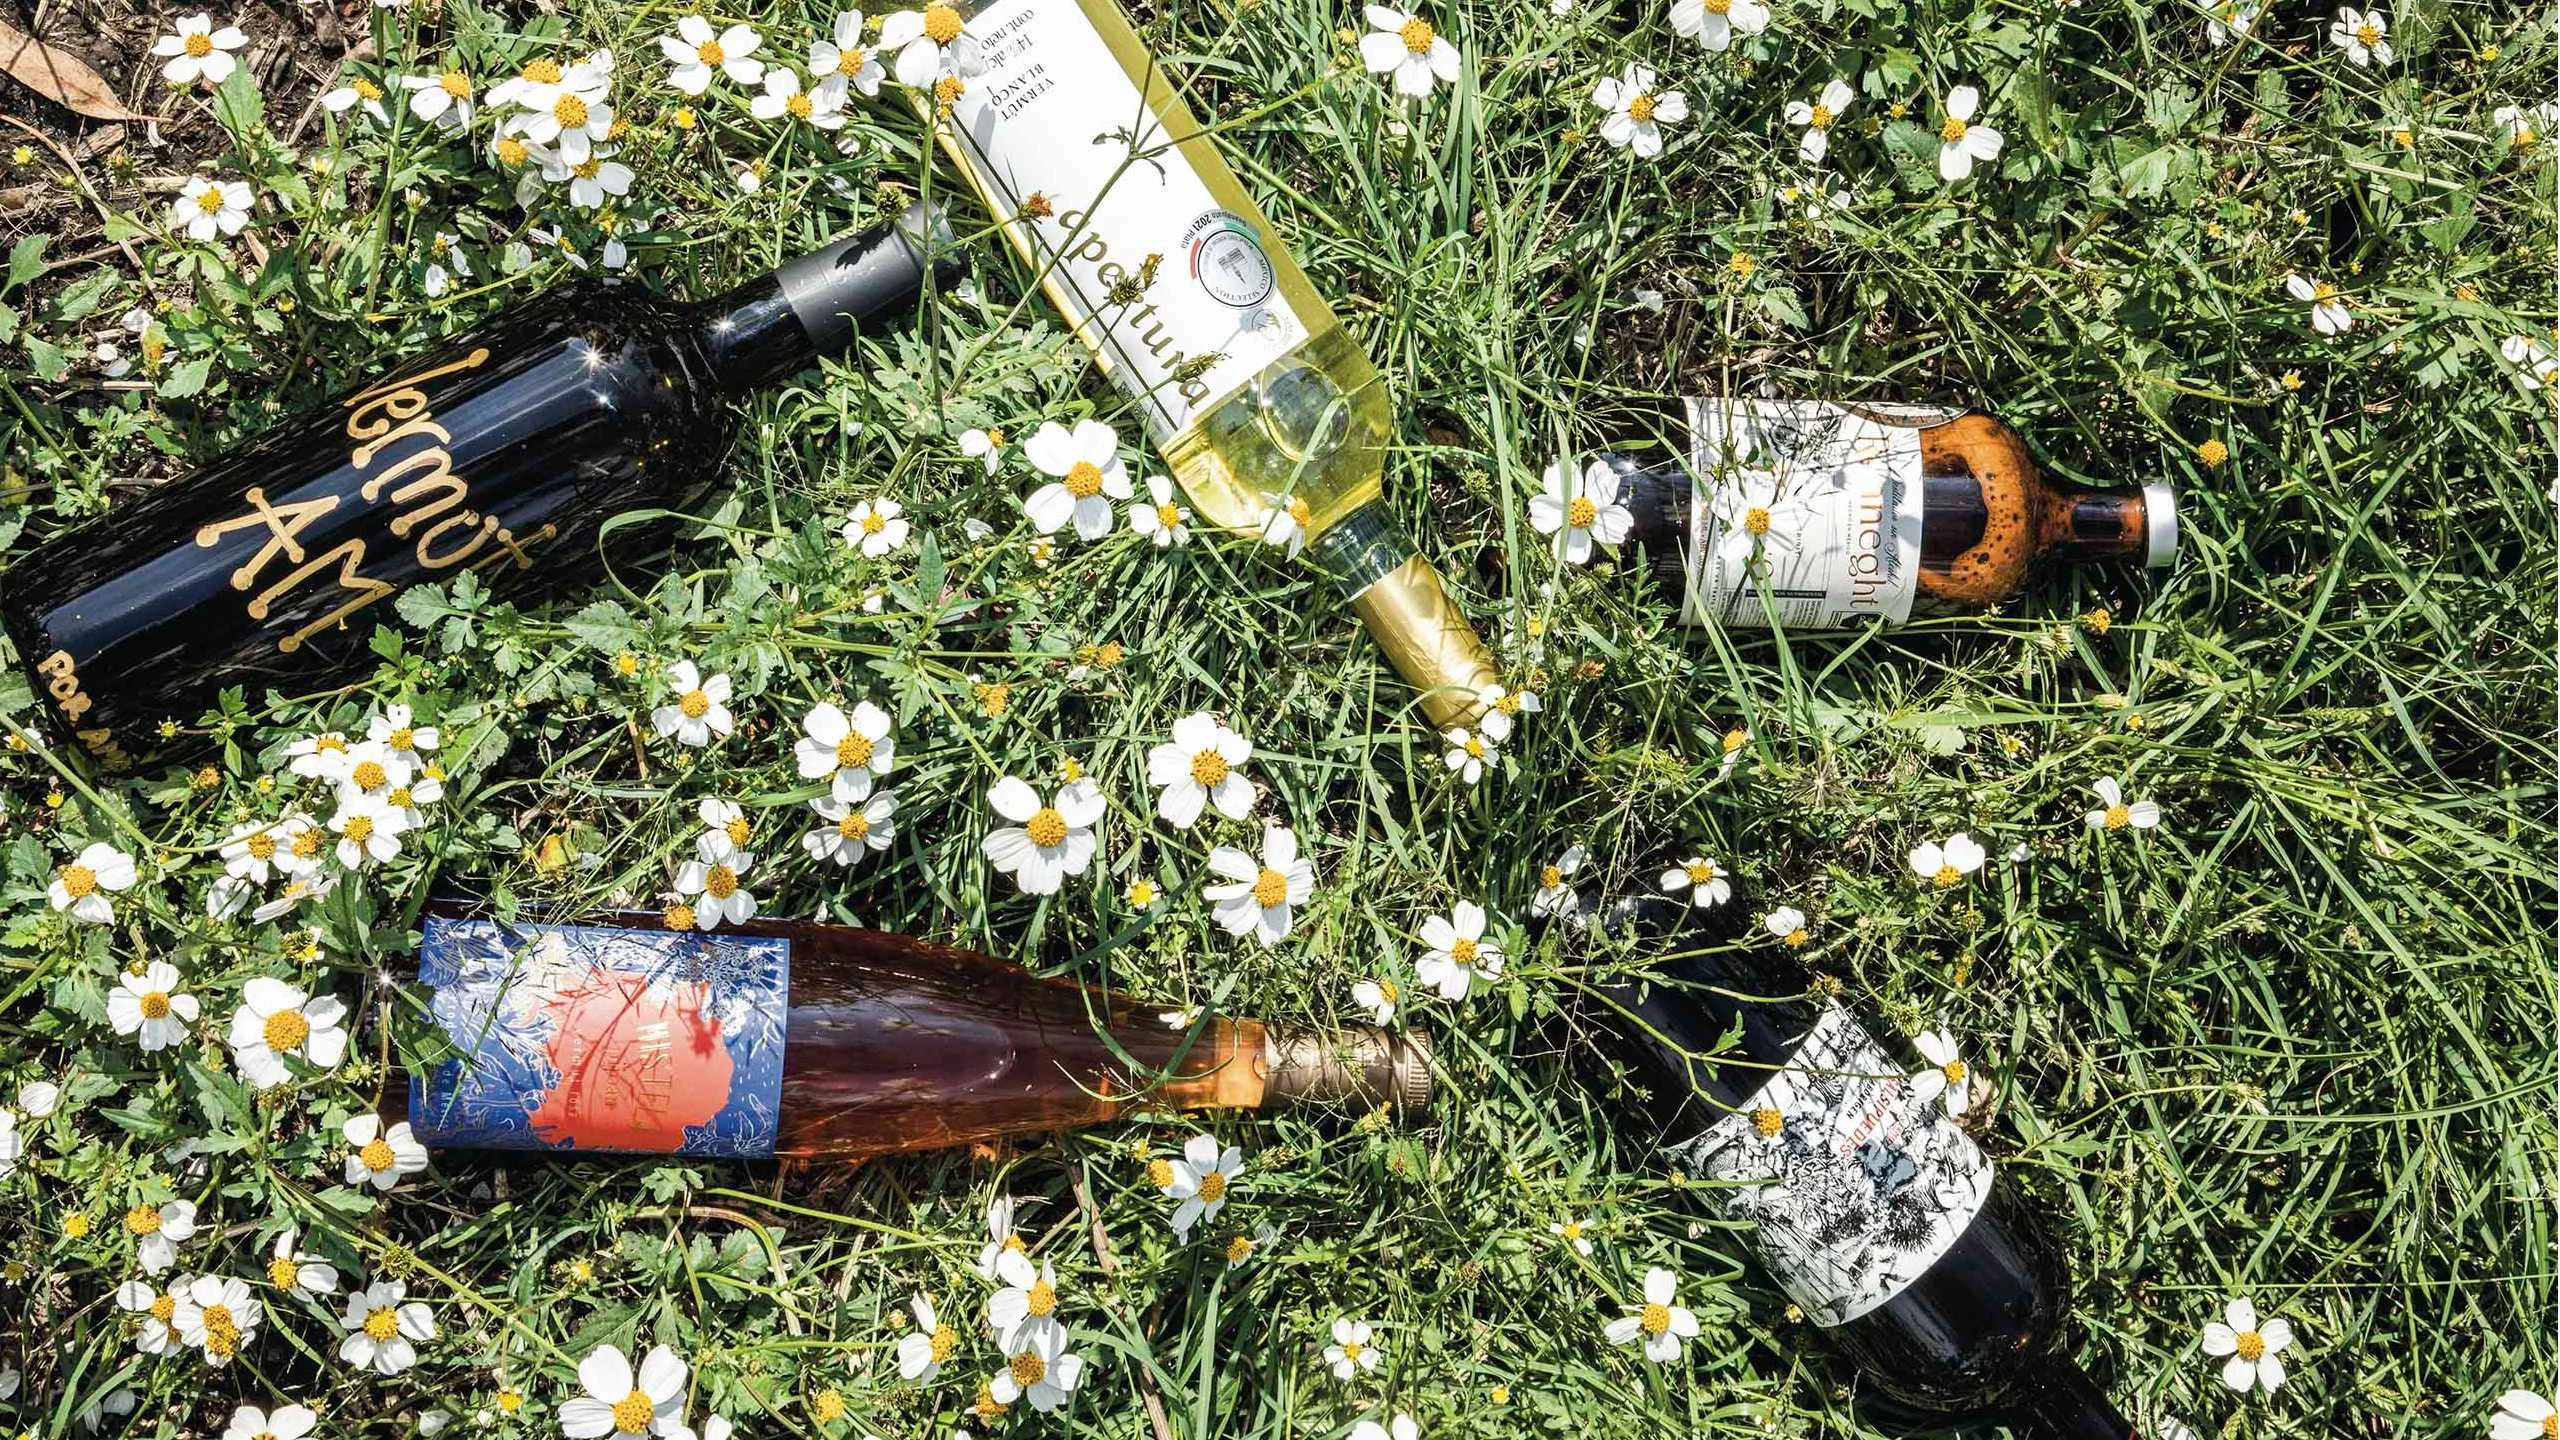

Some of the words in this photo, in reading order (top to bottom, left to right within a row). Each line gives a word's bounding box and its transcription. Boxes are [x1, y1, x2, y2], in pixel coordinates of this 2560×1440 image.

[981, 26, 1008, 51] neto
[991, 63, 1045, 107] BLANCO
[1001, 78, 1056, 121] VERMÚT
[1180, 229, 1197, 249] Plata
[1194, 213, 1213, 232] 2021
[1059, 209, 1212, 410] apetura
[195, 486, 397, 653] AM
